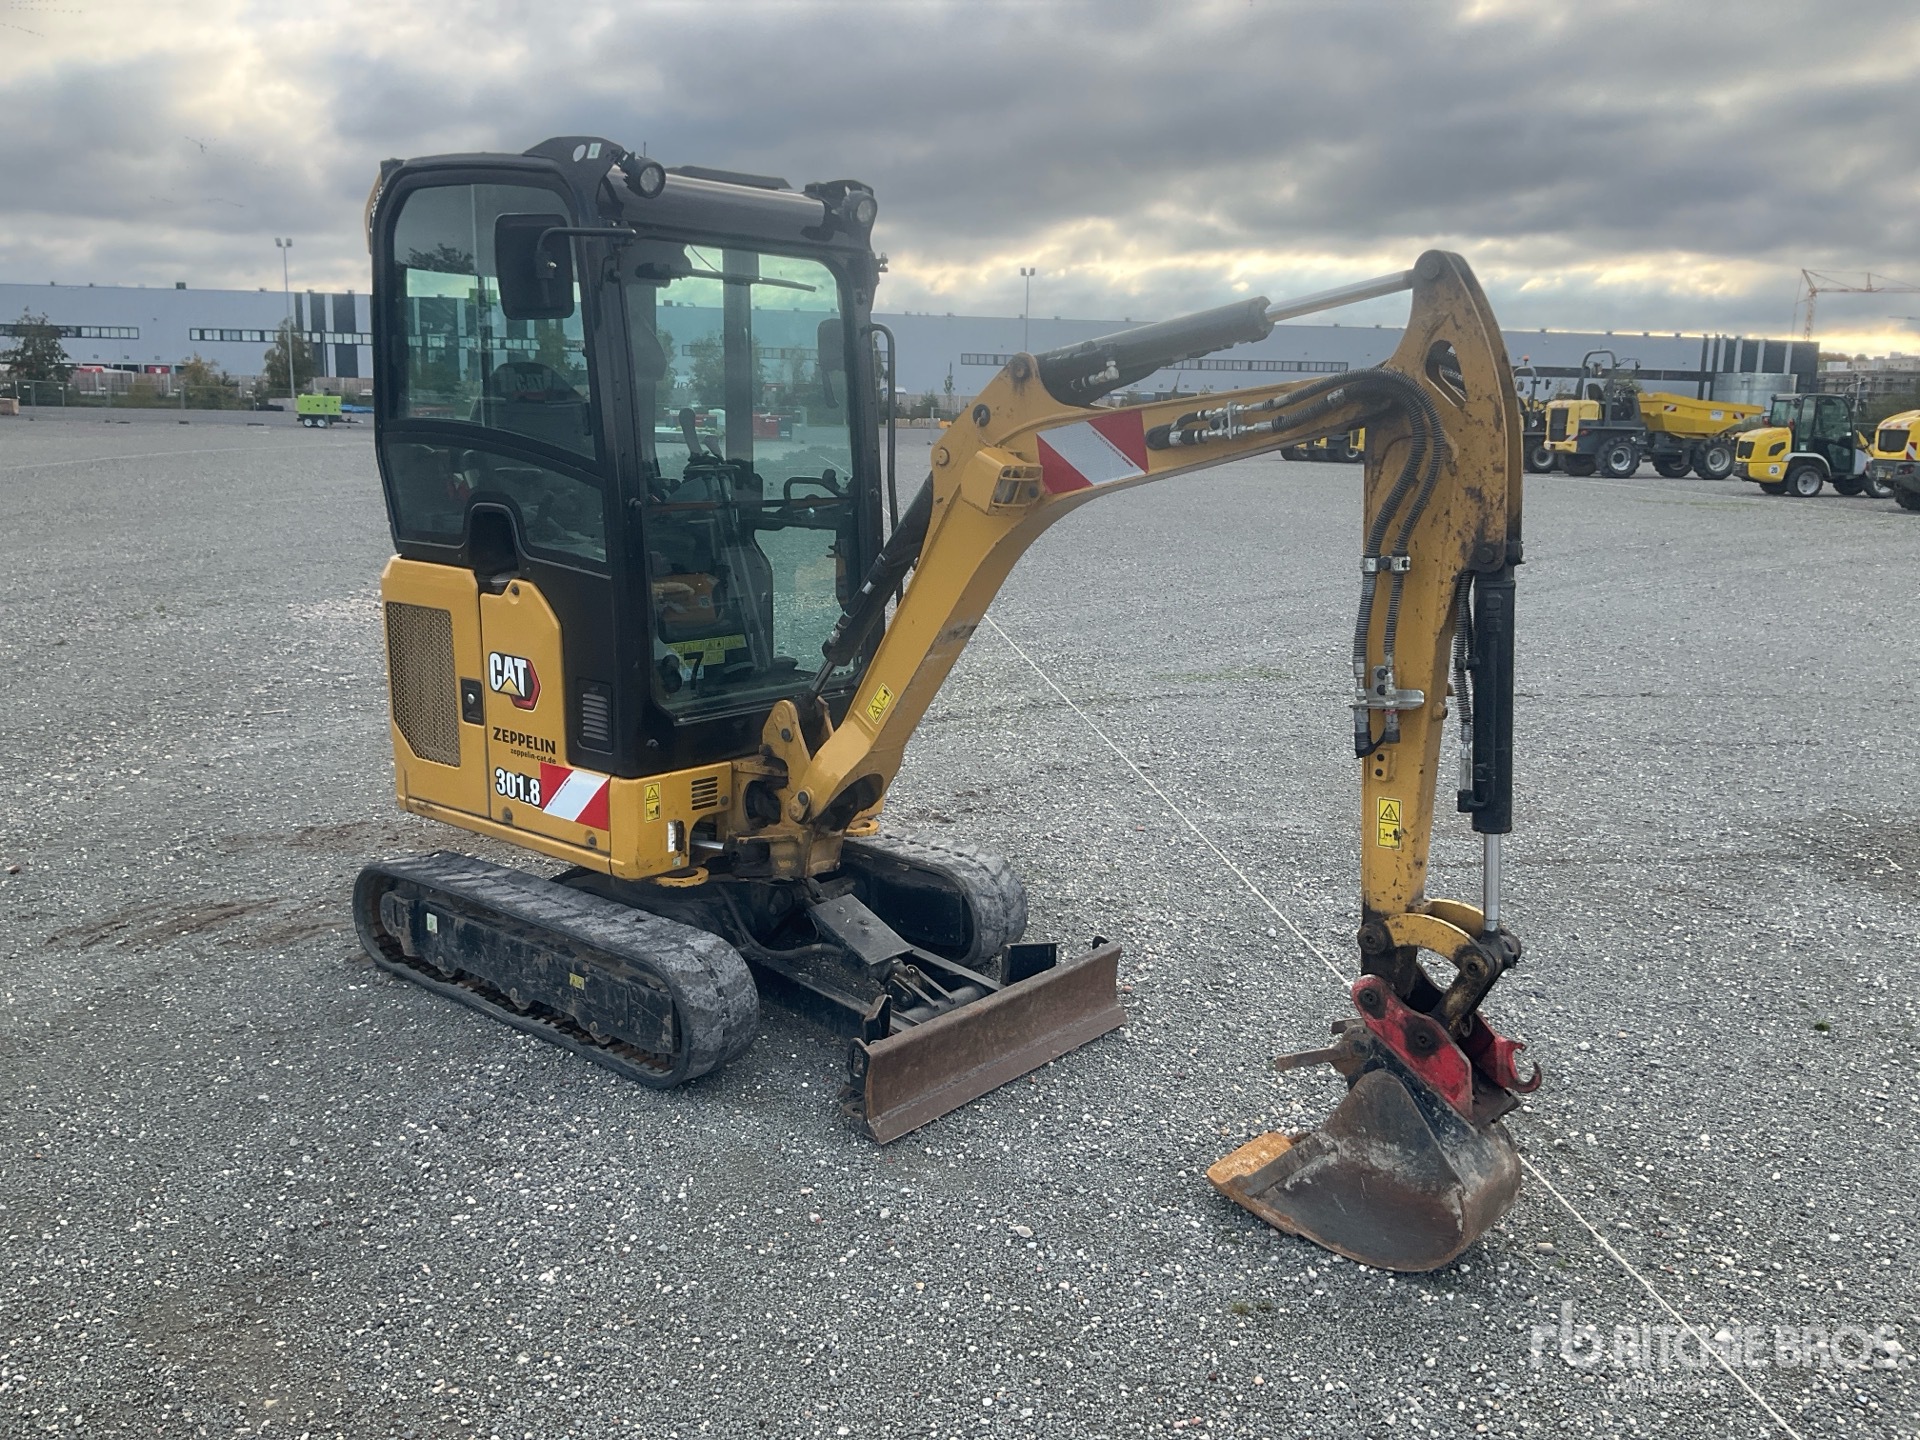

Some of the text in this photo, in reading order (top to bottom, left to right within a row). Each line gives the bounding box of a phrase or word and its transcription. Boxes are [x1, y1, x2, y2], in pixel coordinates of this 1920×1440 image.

[489, 652, 528, 697] CAT
[683, 650, 704, 690] 7
[493, 726, 556, 755] ZEPPELIN
[510, 747, 557, 765] zeppelin-cat.de
[495, 767, 541, 806] 301.8
